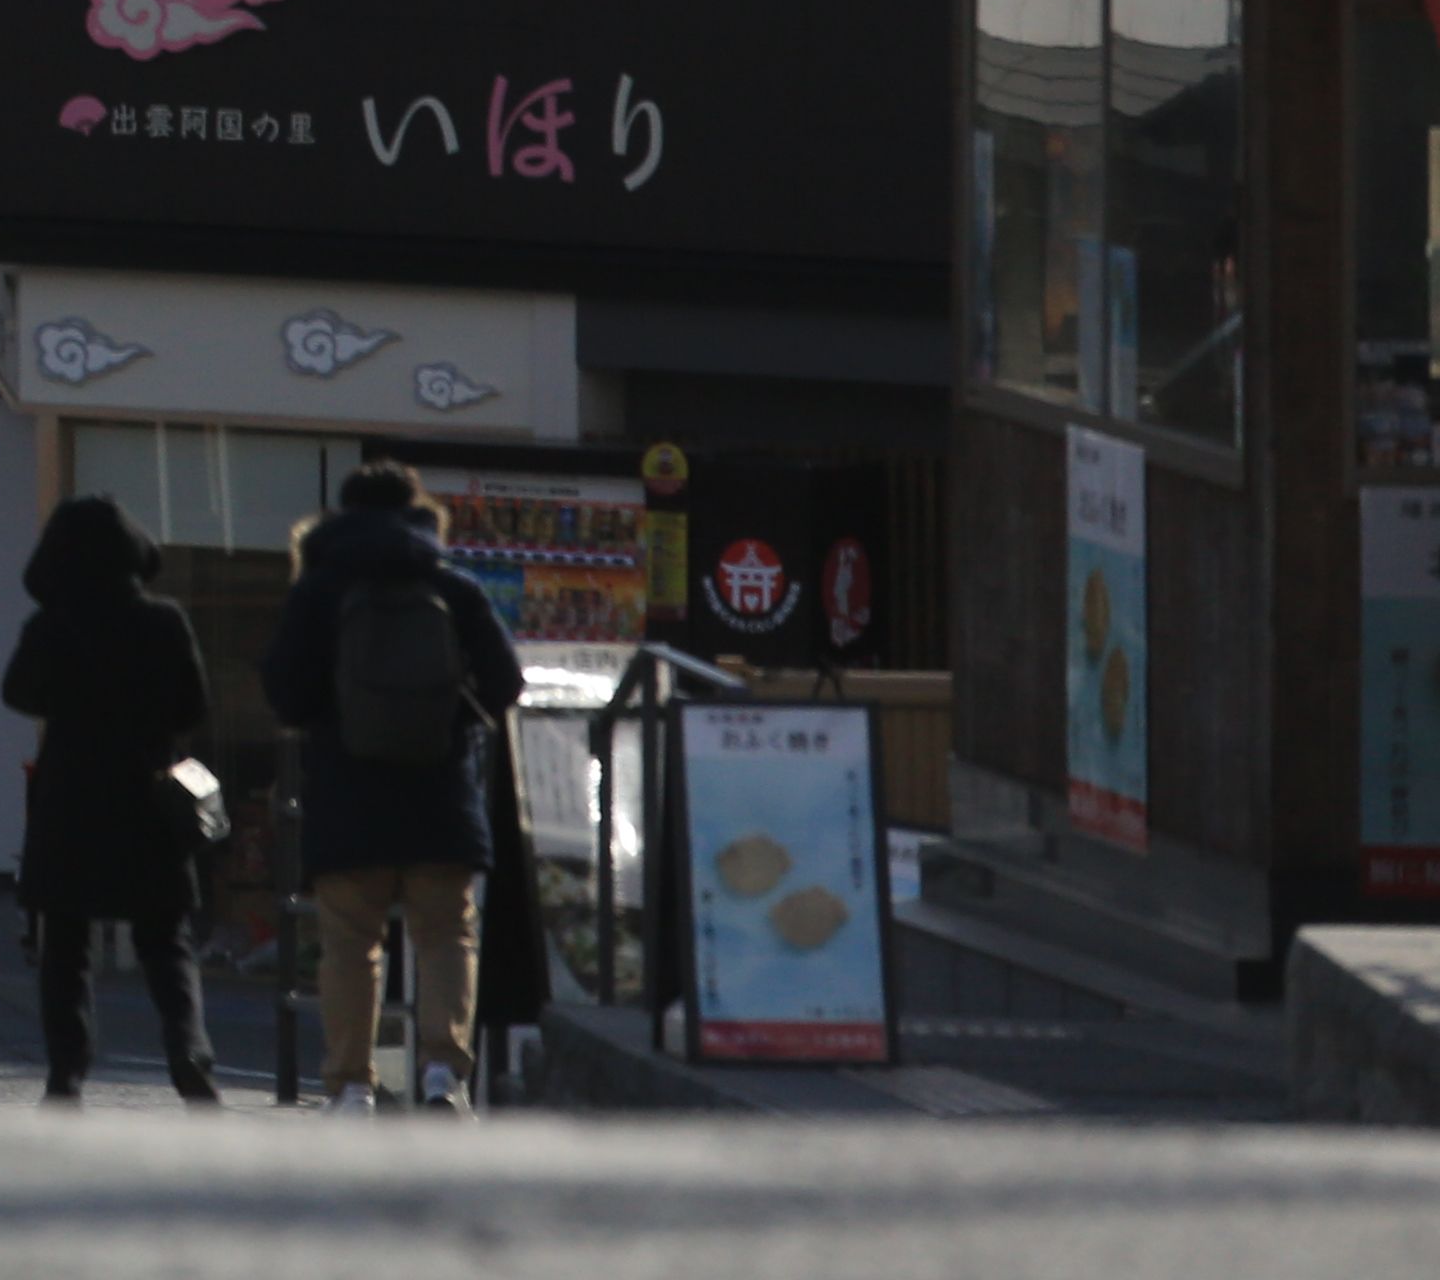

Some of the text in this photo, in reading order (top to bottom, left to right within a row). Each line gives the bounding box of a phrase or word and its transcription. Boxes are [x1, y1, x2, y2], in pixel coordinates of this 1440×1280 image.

[110, 72, 665, 192] 出雲阿国の里 いほり
